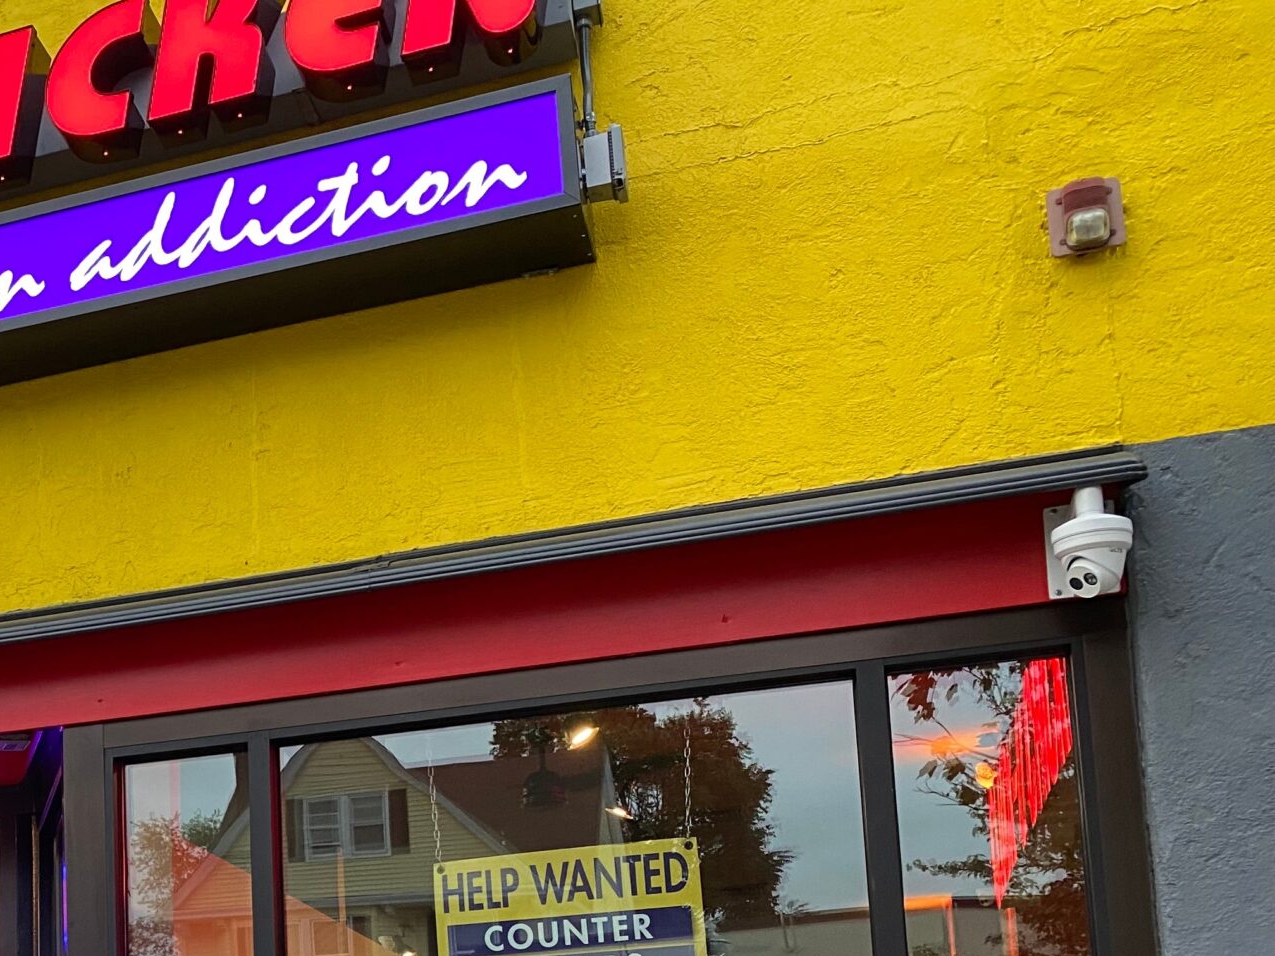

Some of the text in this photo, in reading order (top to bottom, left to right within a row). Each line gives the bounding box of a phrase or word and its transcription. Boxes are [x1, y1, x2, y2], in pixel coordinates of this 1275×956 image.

[69, 155, 528, 292] addiction
[442, 851, 690, 914] HELP WANTED
[484, 913, 654, 952] COUNTER
